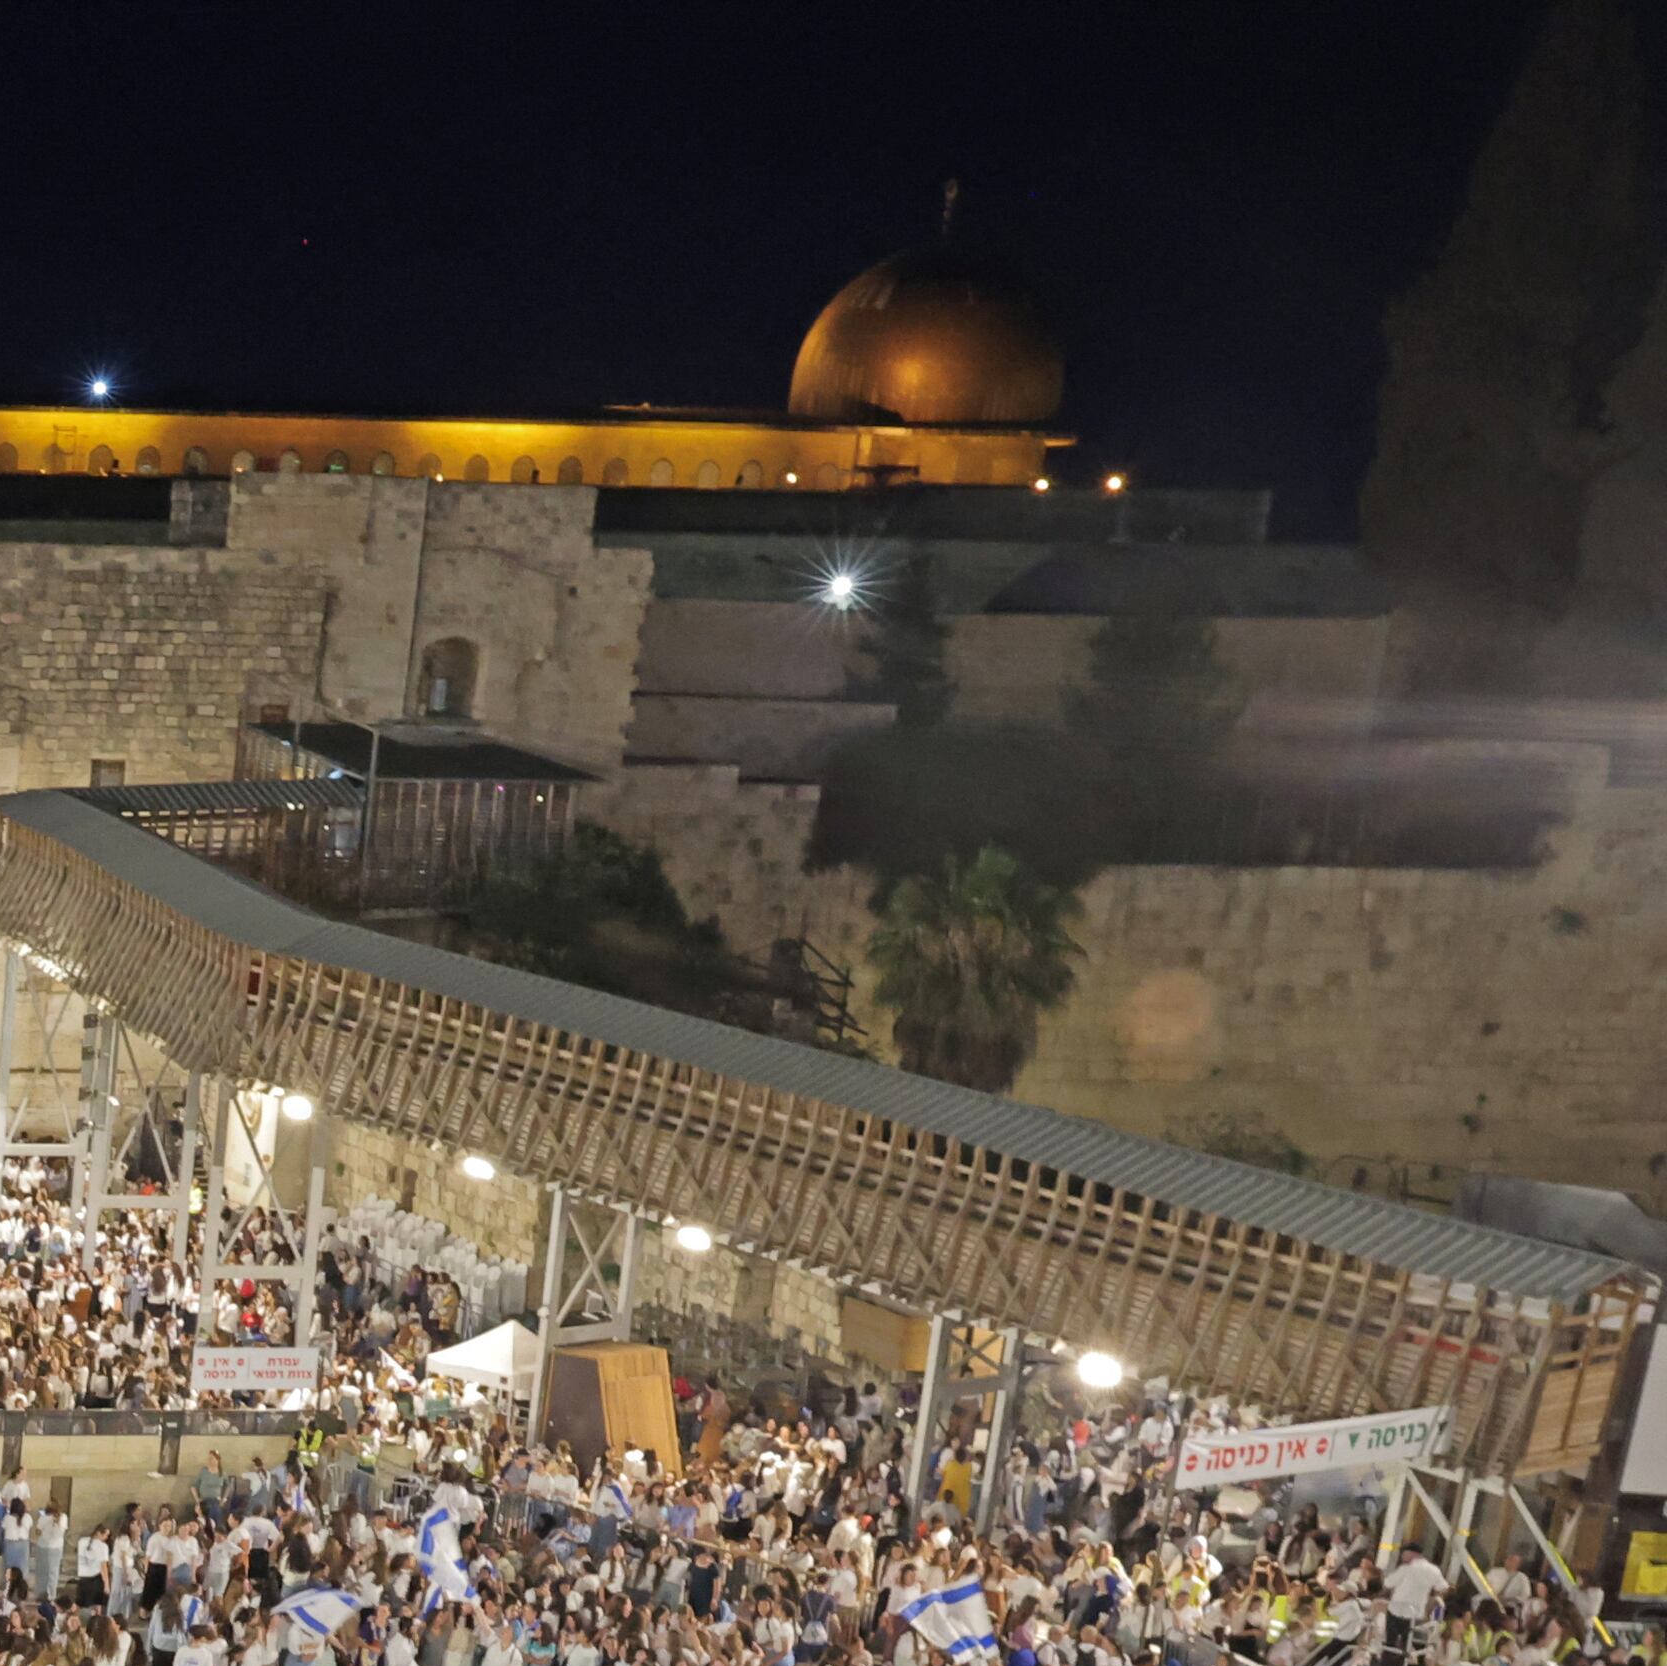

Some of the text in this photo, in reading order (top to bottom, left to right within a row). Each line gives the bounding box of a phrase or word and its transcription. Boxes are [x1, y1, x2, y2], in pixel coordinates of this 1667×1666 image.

[213, 1358, 230, 1368] אין
[204, 1370, 237, 1379] כניסה
[1367, 1422, 1430, 1449] כניסה
[1205, 1438, 1307, 1471] אין כניסה
